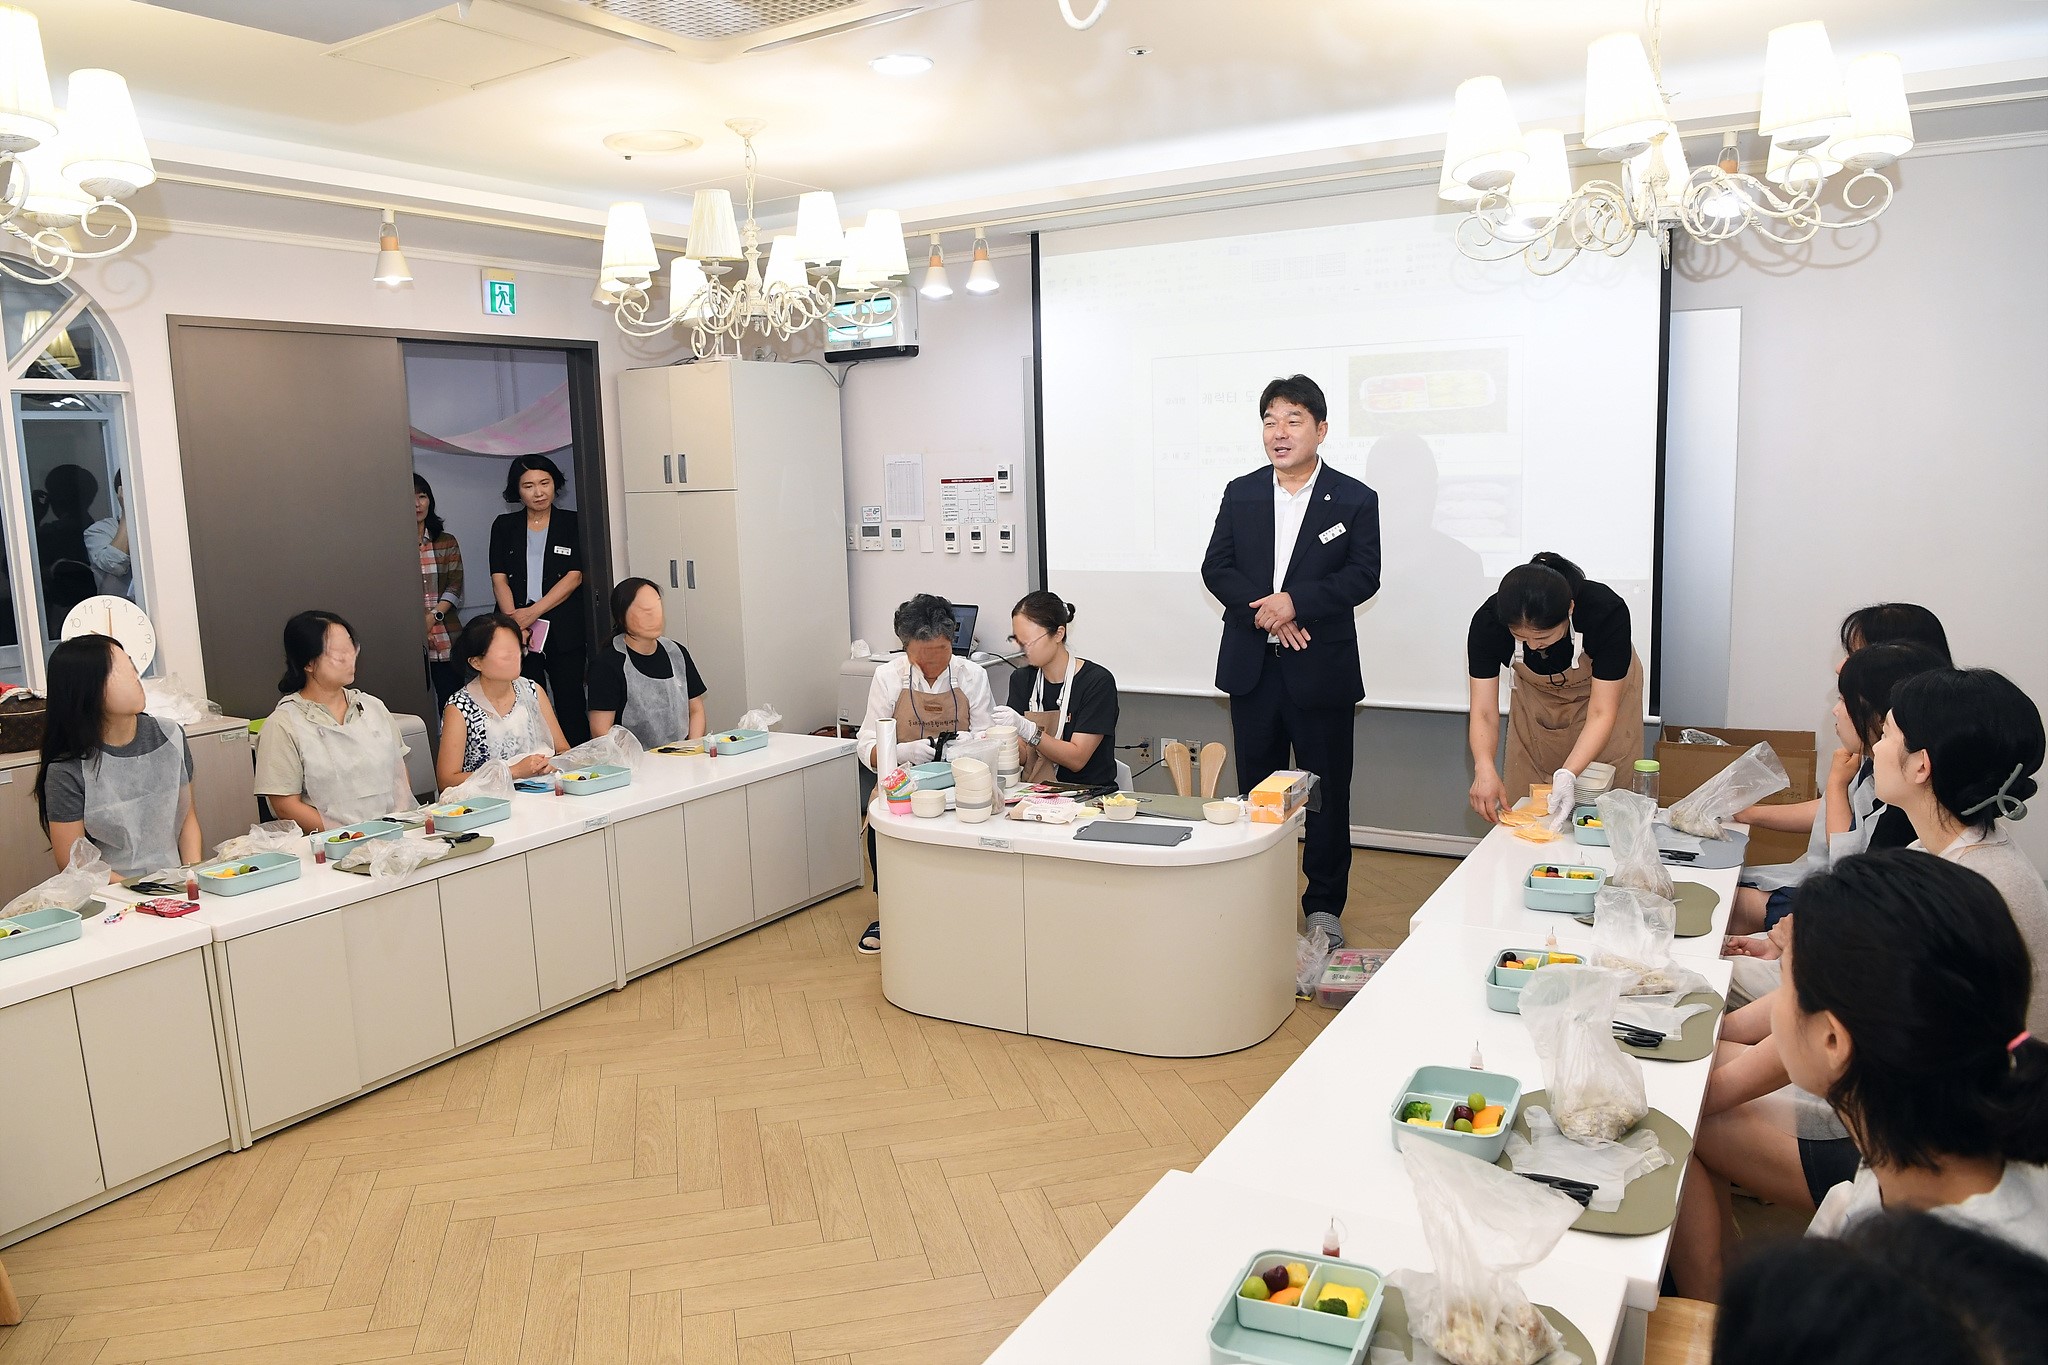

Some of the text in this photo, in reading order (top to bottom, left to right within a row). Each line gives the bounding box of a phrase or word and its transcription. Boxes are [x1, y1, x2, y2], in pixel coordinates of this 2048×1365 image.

[1201, 391, 1237, 405] 캐릭터
[101, 599, 112, 609] 12
[124, 603, 128, 612] 1
[83, 605, 93, 614] 11
[70, 617, 81, 628] 10
[137, 615, 144, 625] 2
[145, 633, 151, 644] 3
[141, 652, 147, 661] 4
